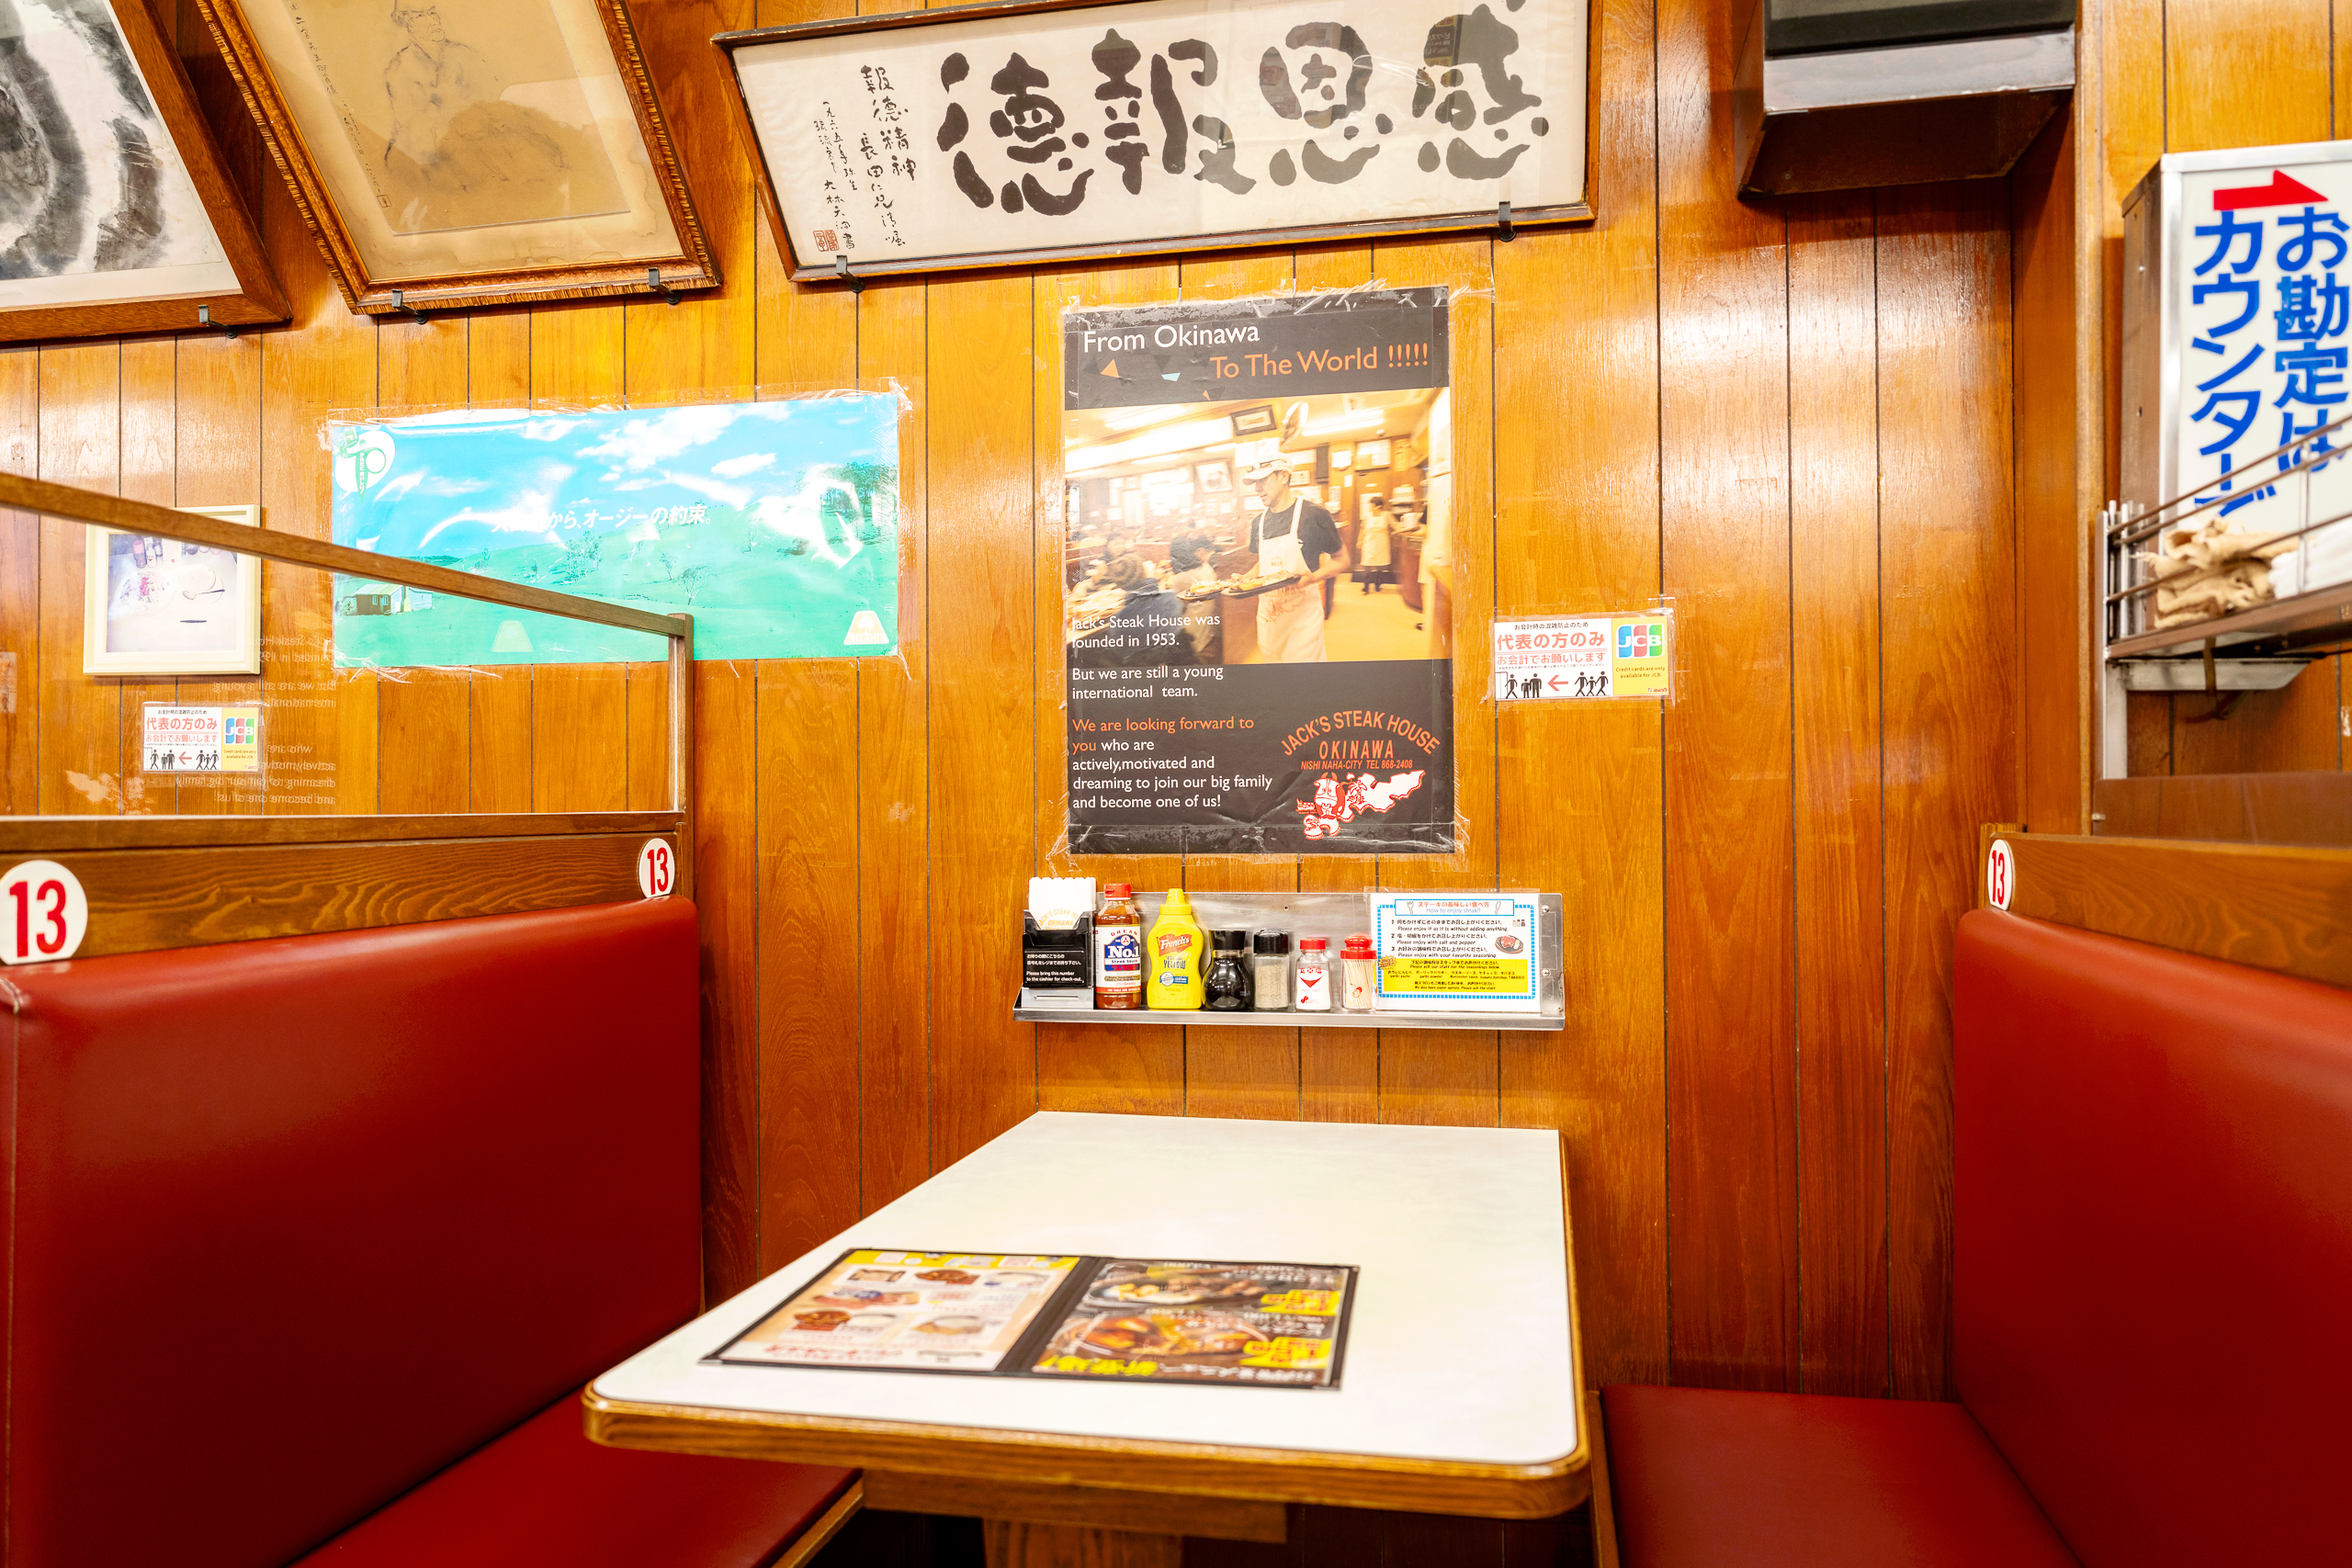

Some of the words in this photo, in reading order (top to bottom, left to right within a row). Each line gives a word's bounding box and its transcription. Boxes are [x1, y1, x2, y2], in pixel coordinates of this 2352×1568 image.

[1083, 331, 1145, 354] From
[1154, 322, 1261, 349] Okinawa
[2274, 206, 2351, 474] お勘定は
[1209, 355, 1240, 379] To
[1244, 354, 1293, 378] The
[1296, 345, 1378, 374] World
[1387, 342, 1430, 367] !!!!!
[1109, 615, 1145, 628] Steak
[1148, 614, 1192, 627] House
[1195, 615, 1221, 626] was
[1072, 635, 1124, 649] founded
[1128, 635, 1140, 647] in
[1146, 633, 1180, 647] 1953.
[1497, 631, 1606, 651] 代表の方のみ
[1497, 651, 1607, 666] お会計でお願いします
[1072, 668, 1095, 681] But
[1098, 670, 1117, 680] we
[1121, 669, 1142, 680] are
[1146, 665, 1169, 679] still
[1172, 669, 1181, 678] a
[1183, 666, 1224, 682] young
[1072, 685, 1154, 700] international
[1161, 687, 1198, 698] team.
[146, 716, 218, 731] 代表の方のみ
[1072, 718, 1096, 732] We
[1101, 721, 1122, 731] are
[1125, 717, 1176, 734] looking
[1180, 716, 1235, 730] forward
[1238, 717, 1255, 729] to
[1332, 709, 1386, 730] STEAK
[1386, 714, 1442, 755] HOUSE
[145, 734, 218, 743] お会計でお願いします
[1072, 741, 1097, 756] you
[1101, 739, 1130, 751] who
[1133, 740, 1155, 751] are
[1318, 739, 1395, 761] OKINAWA
[1072, 756, 1187, 773] actively,motivated
[1191, 755, 1216, 769] and
[1300, 760, 1322, 771] NISHI
[1321, 760, 1363, 771] NAHA-CITY
[1365, 760, 1380, 770] TEL
[1381, 759, 1414, 770] 868-2408
[1072, 776, 1133, 793] dreaming
[1136, 777, 1150, 789] to
[1154, 776, 1179, 792] join
[1182, 777, 1207, 788] our
[1211, 775, 1231, 792] big
[1234, 773, 1273, 791] family
[1072, 795, 1096, 808] and
[1100, 795, 1152, 808] become
[1156, 797, 1181, 807] one
[1184, 794, 1200, 807] of
[1203, 794, 1222, 807] us!
[647, 846, 669, 896] 13
[1991, 850, 2006, 906] 13
[9, 879, 67, 958] 13
[1053, 908, 1071, 917] STEAK
[1107, 945, 1140, 958] No.1
